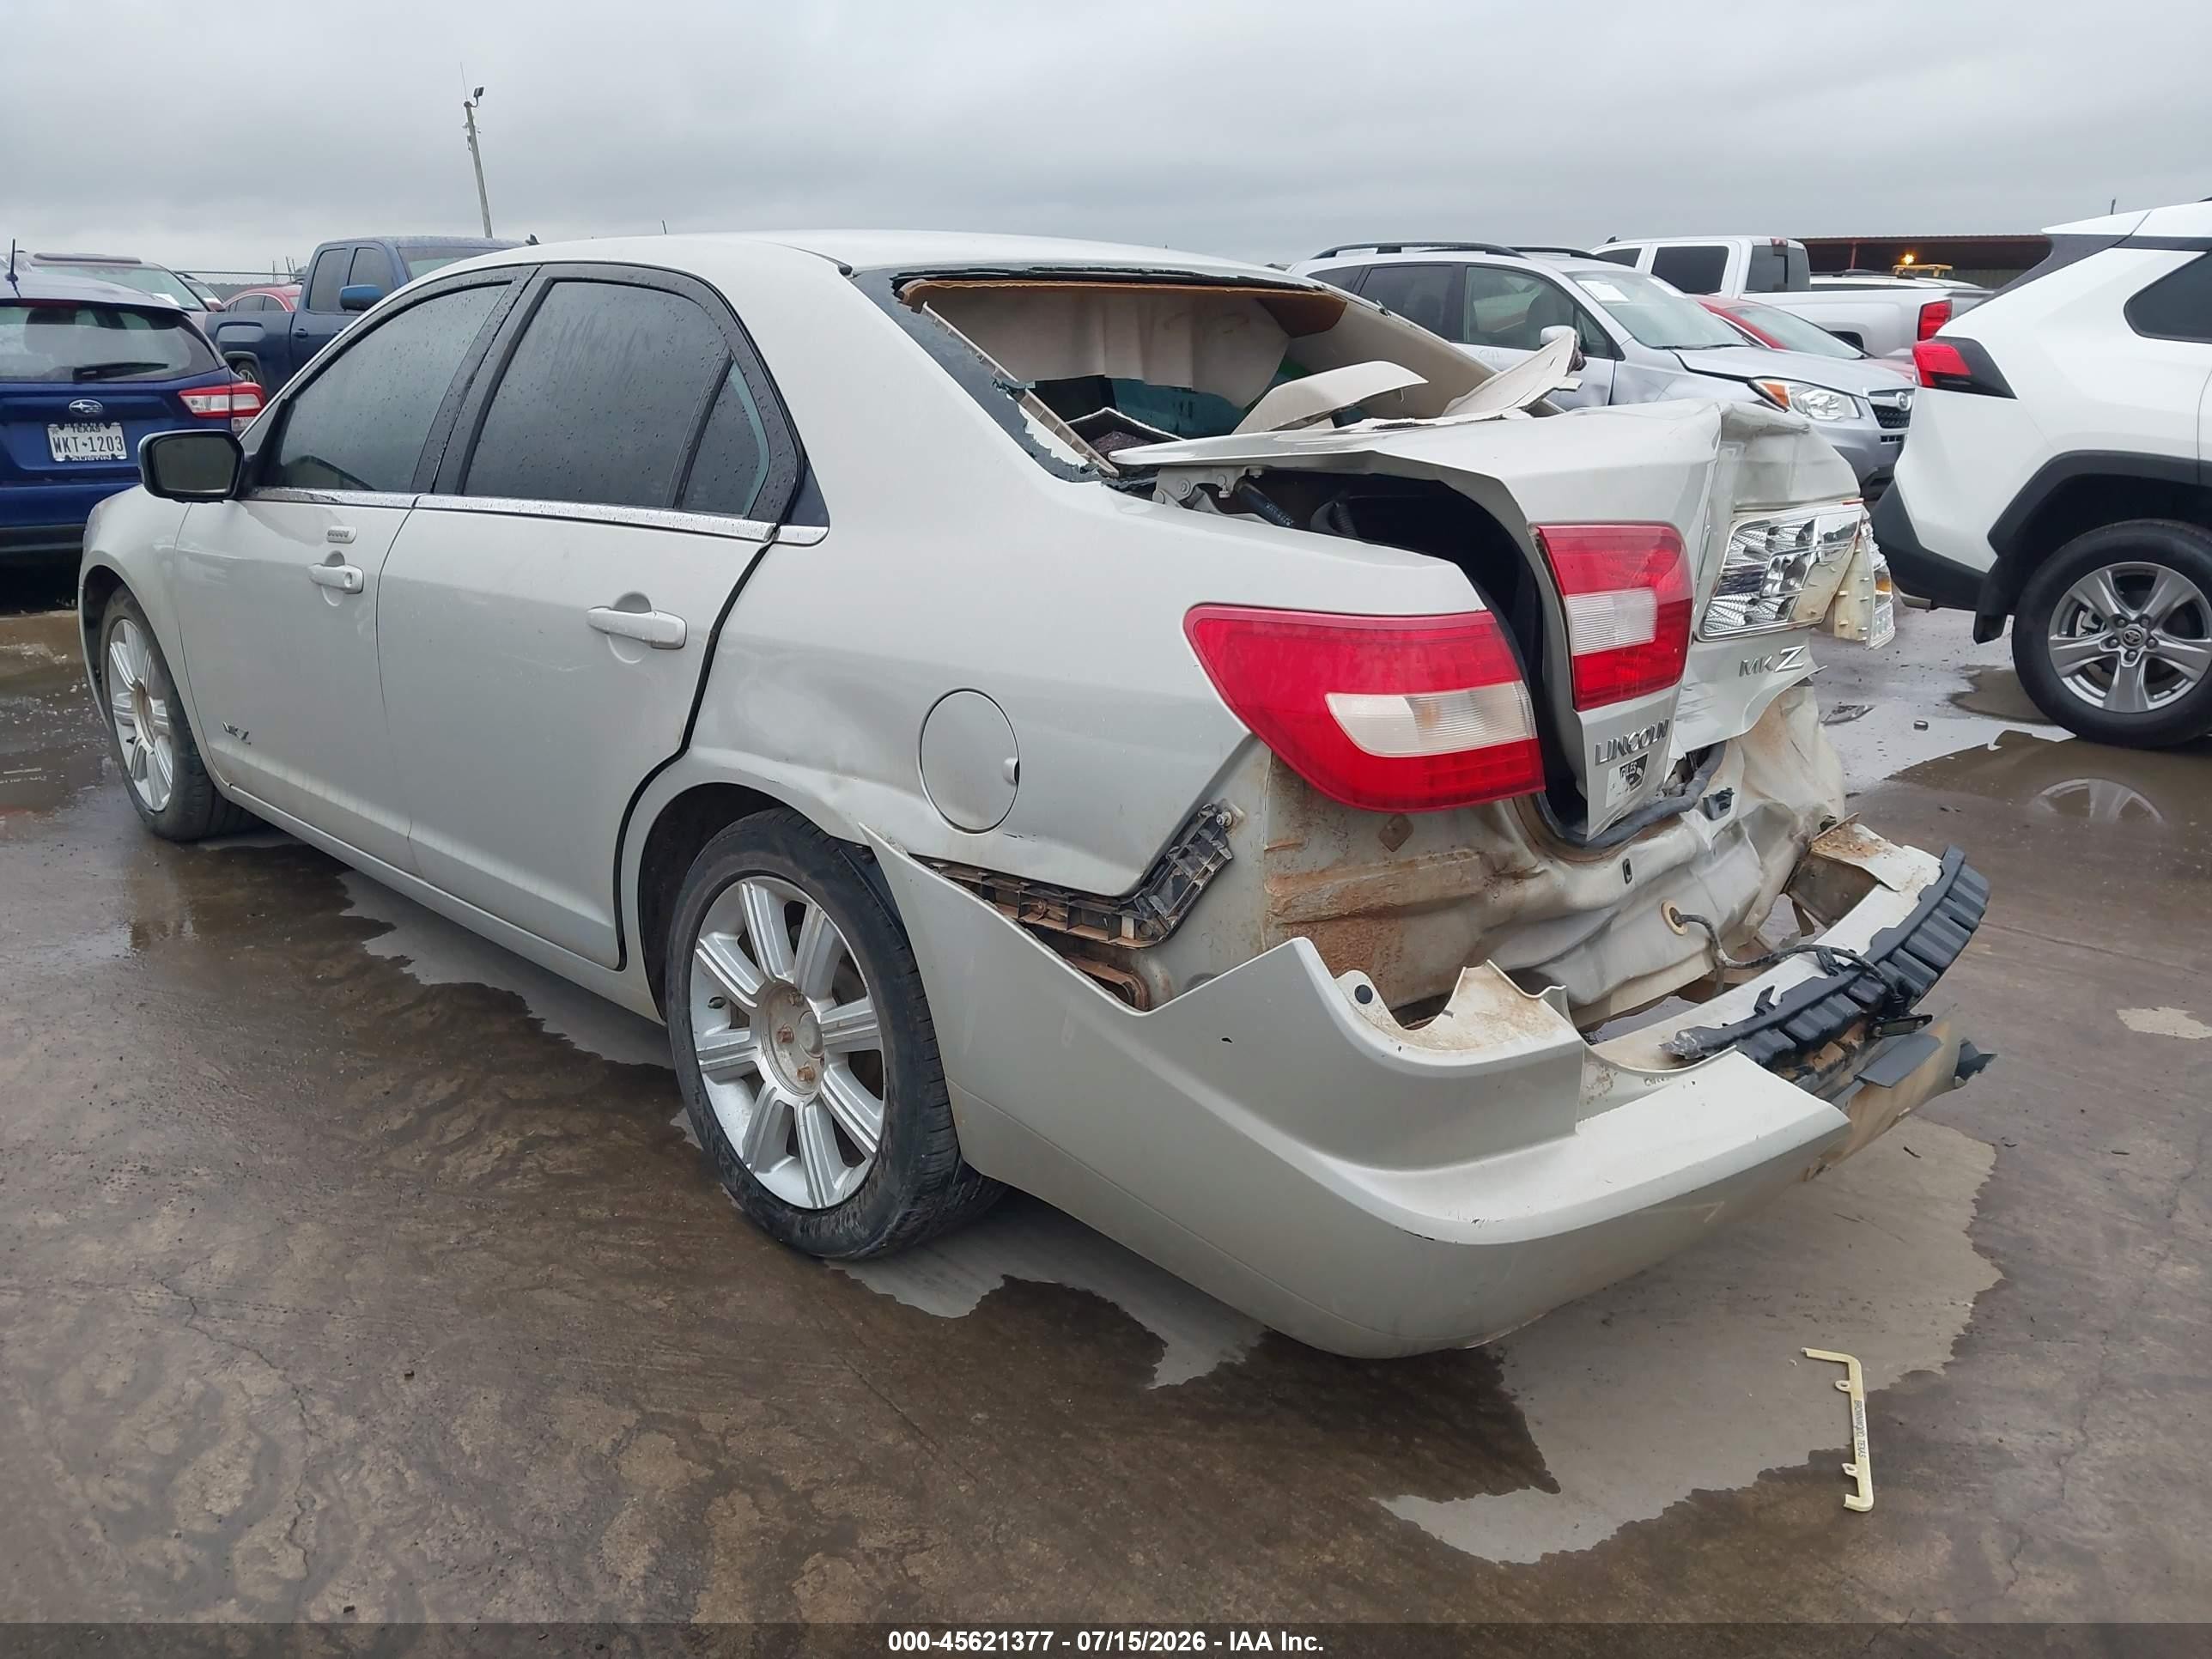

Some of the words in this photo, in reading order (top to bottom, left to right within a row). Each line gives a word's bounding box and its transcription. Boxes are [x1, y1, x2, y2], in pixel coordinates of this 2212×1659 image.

[72, 425, 101, 434] TEXAS
[1595, 718, 1669, 766] LINCOLN
[1857, 1440, 1867, 1458] TEXAS
